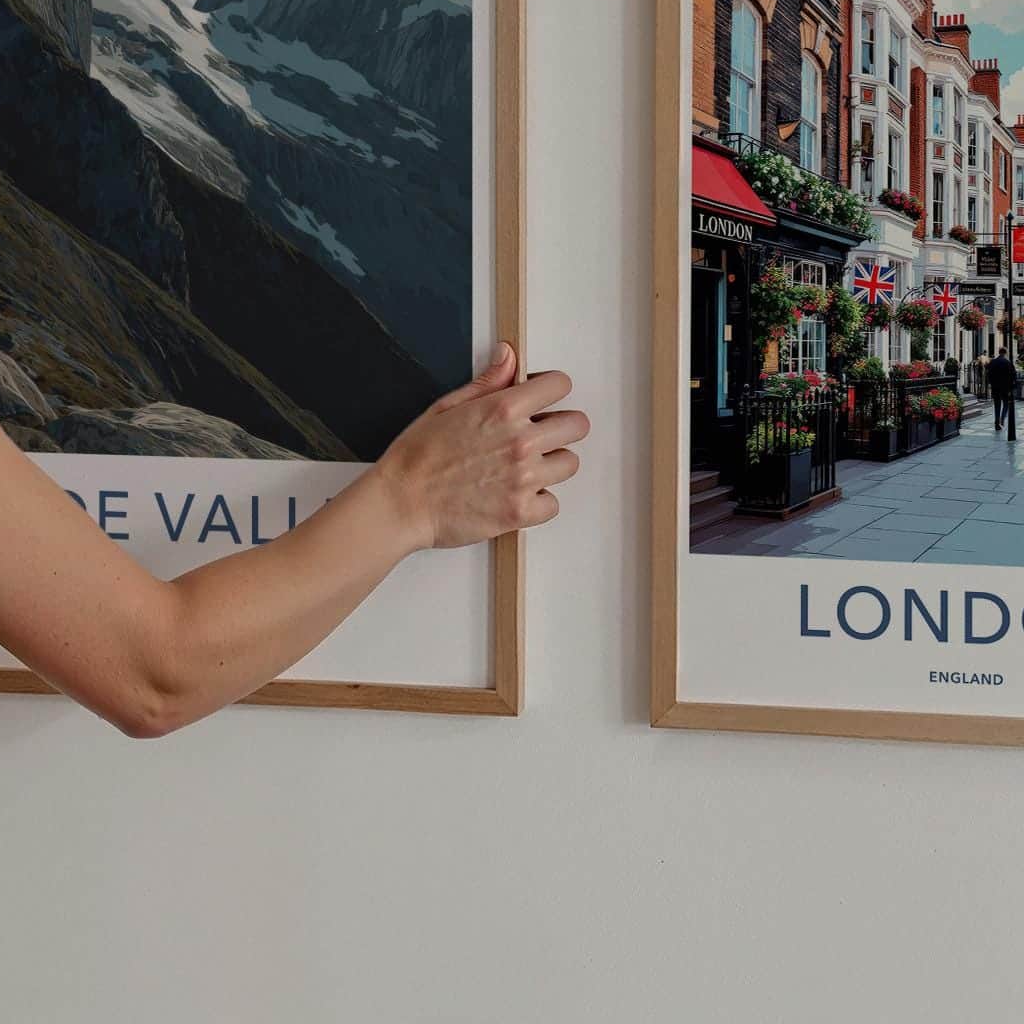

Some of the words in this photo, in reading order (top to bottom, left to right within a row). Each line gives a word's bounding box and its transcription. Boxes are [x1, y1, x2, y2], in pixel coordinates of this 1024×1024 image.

[699, 213, 753, 242] LONDON
[800, 583, 1024, 645] LOND
[929, 670, 1004, 686] ENGLAND
